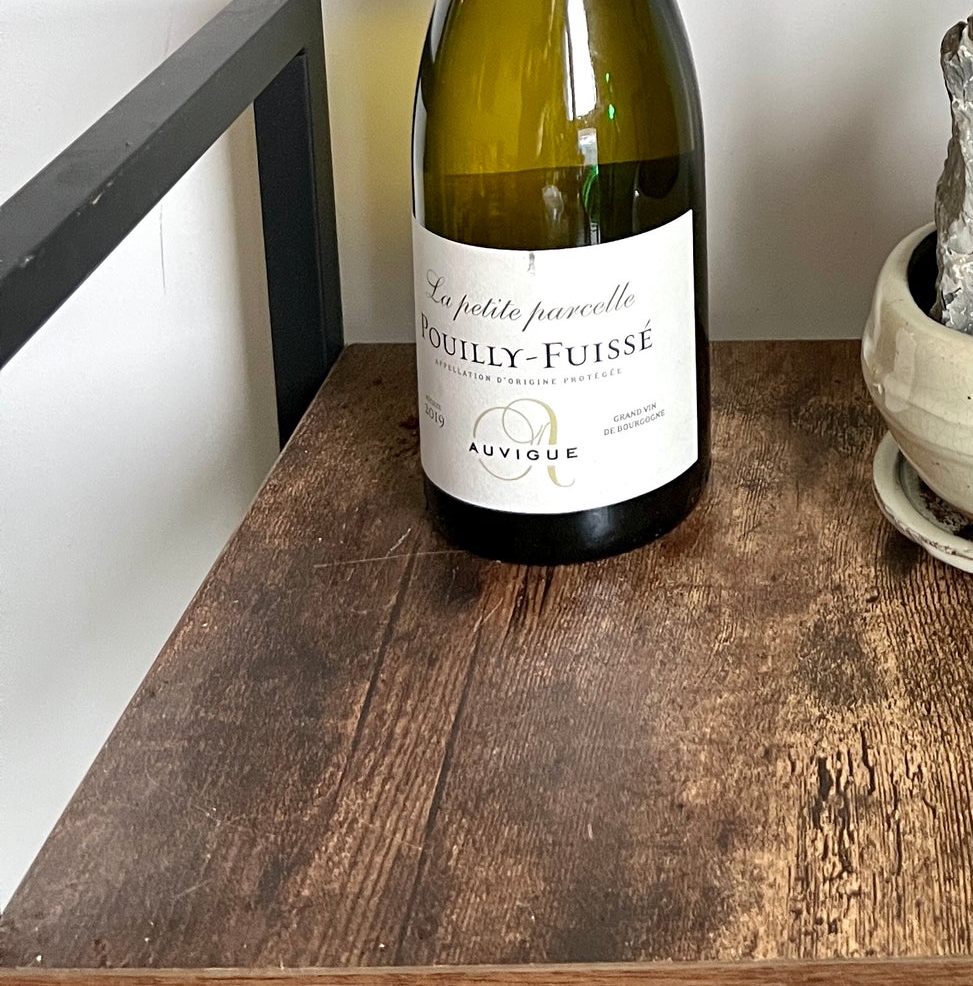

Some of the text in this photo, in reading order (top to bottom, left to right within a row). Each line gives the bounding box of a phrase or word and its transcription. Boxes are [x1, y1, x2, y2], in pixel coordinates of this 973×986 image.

[426, 268, 636, 332] La petite parcelle
[421, 311, 653, 369] POUILLY-FUISSÉ
[435, 358, 622, 386] APPELLATION D'ORIGINE PROTÉGÉE
[425, 403, 445, 428] 2019
[603, 409, 666, 436] DE BOURGOGNE
[613, 402, 657, 422] GRAND VIN
[469, 442, 578, 461] AUVIGUE
